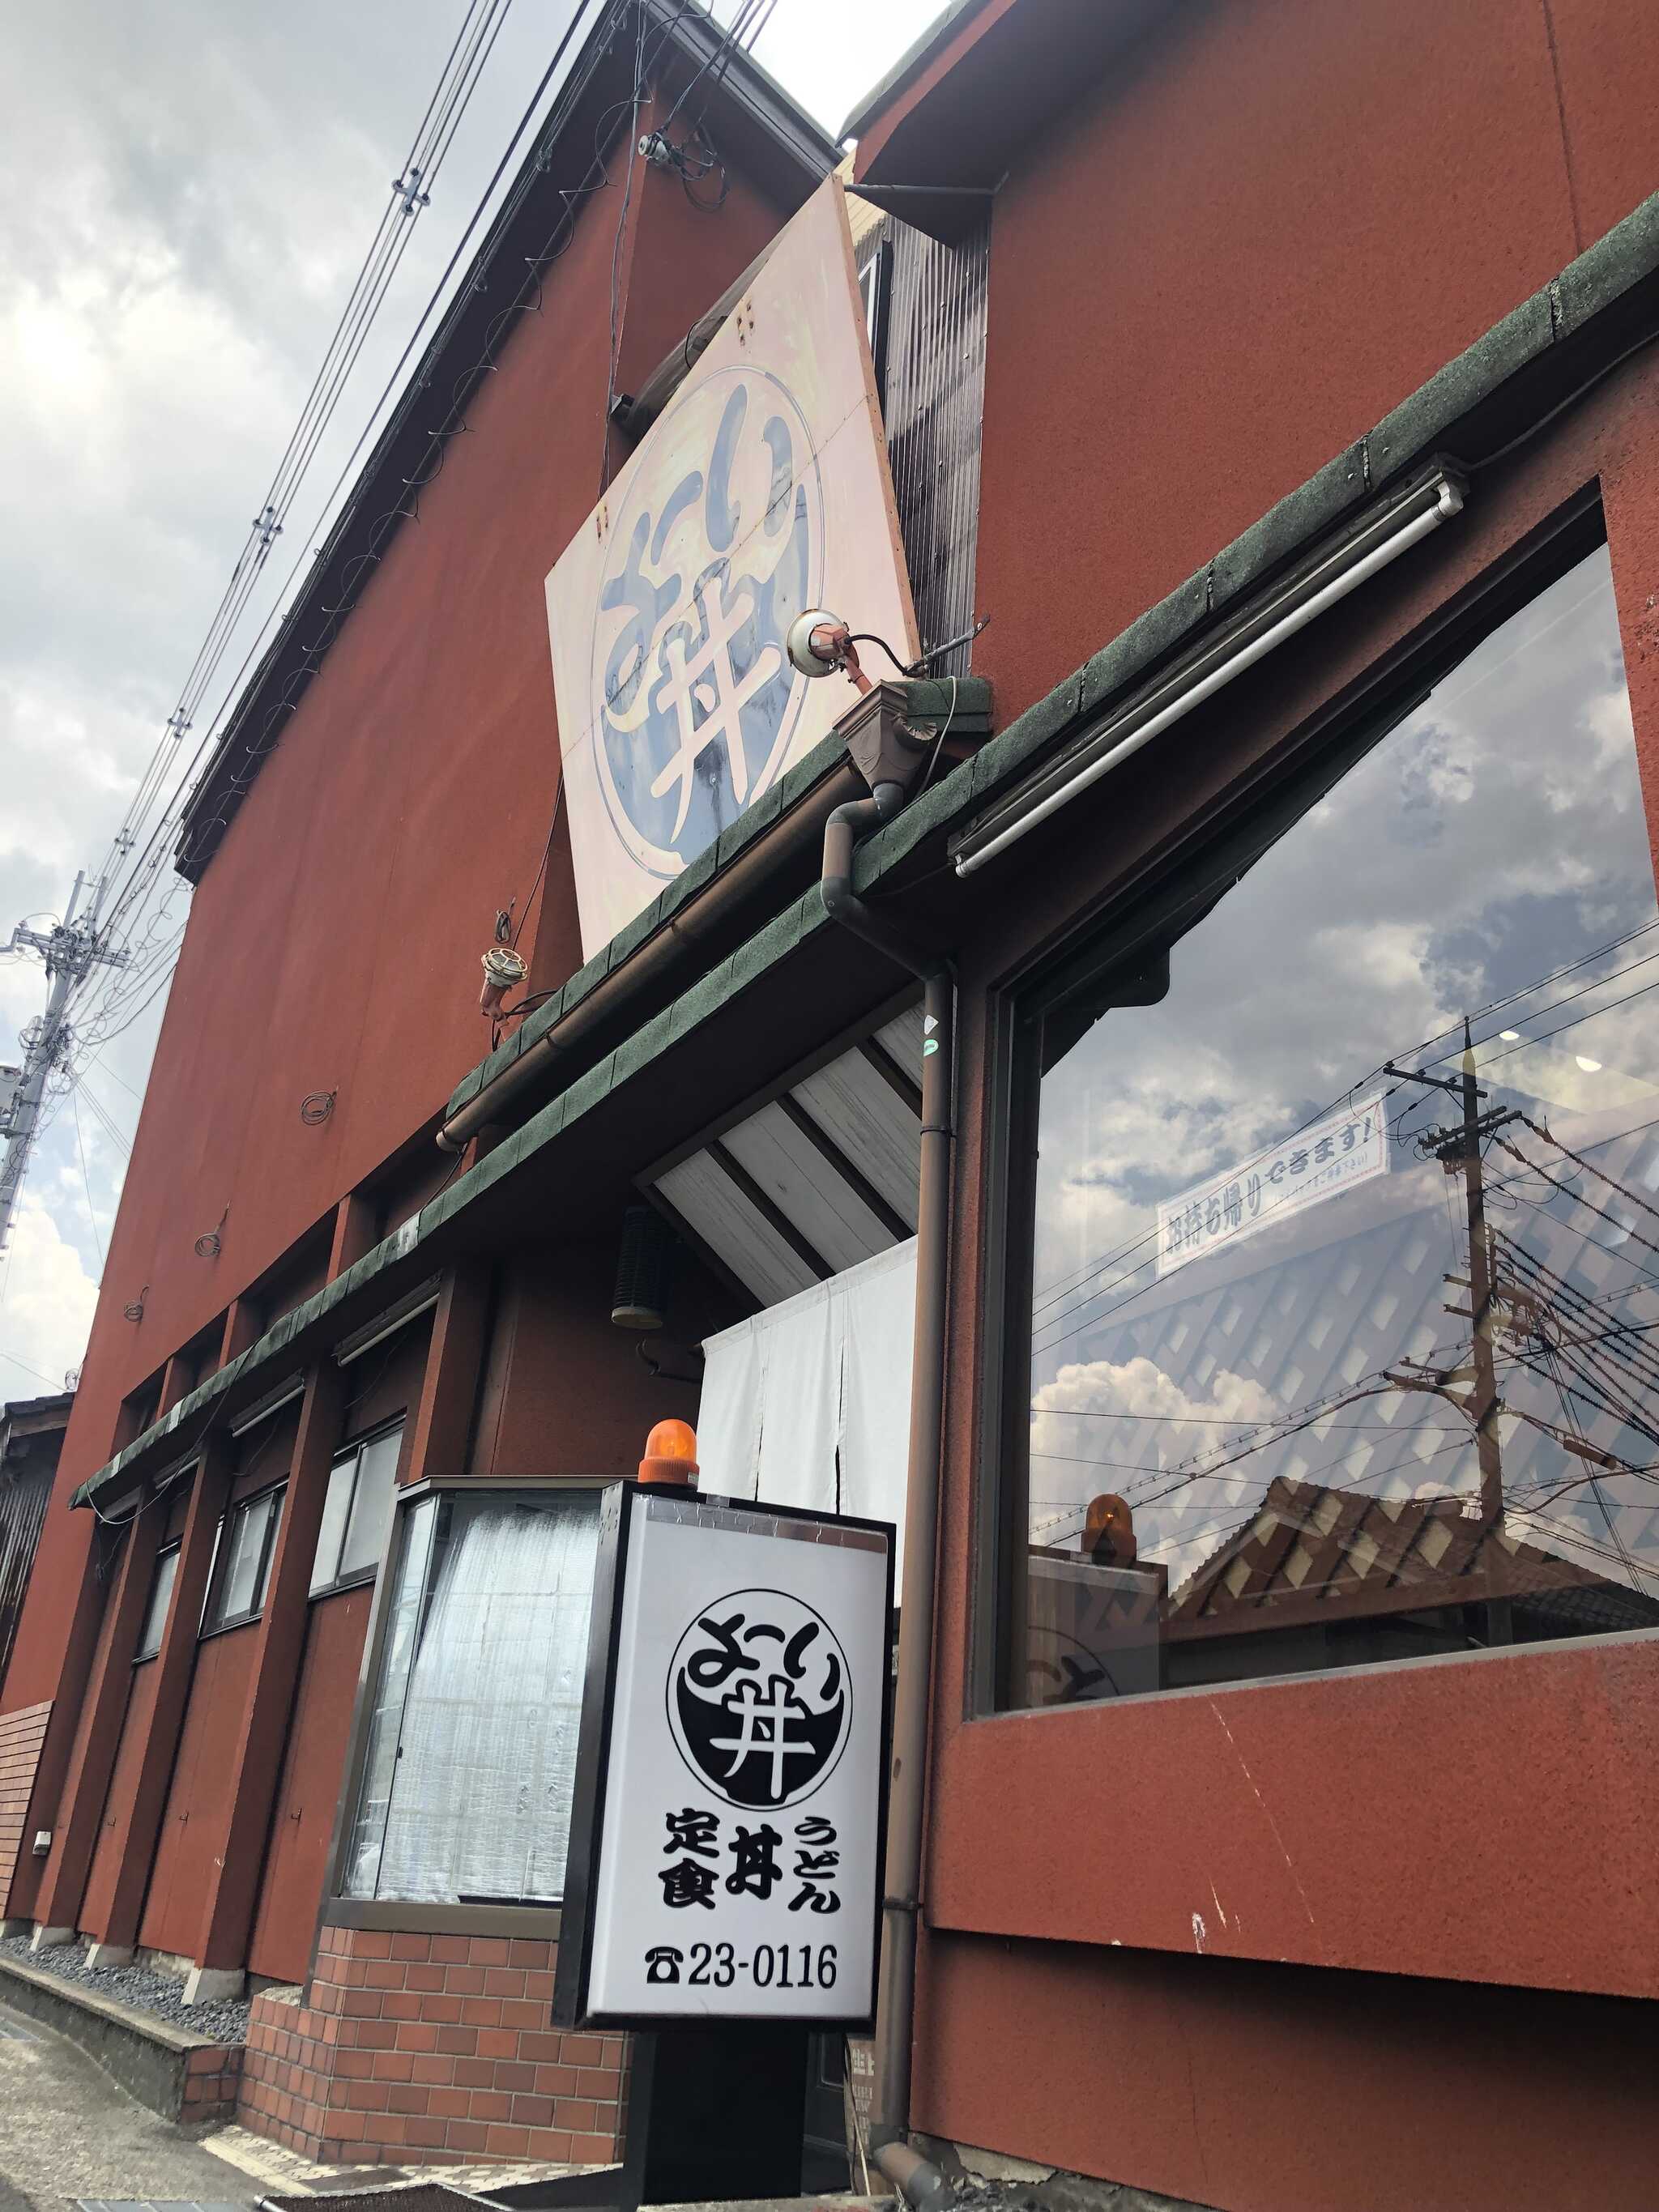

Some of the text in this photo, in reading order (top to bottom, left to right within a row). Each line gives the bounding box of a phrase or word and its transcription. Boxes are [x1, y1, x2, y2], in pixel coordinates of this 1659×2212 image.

[709, 1679, 817, 1800] 丼
[658, 1807, 720, 1910] 定食
[725, 1823, 783, 1900] 丼
[787, 1816, 842, 1915] うどん
[688, 1942, 838, 1989] 23-0116
